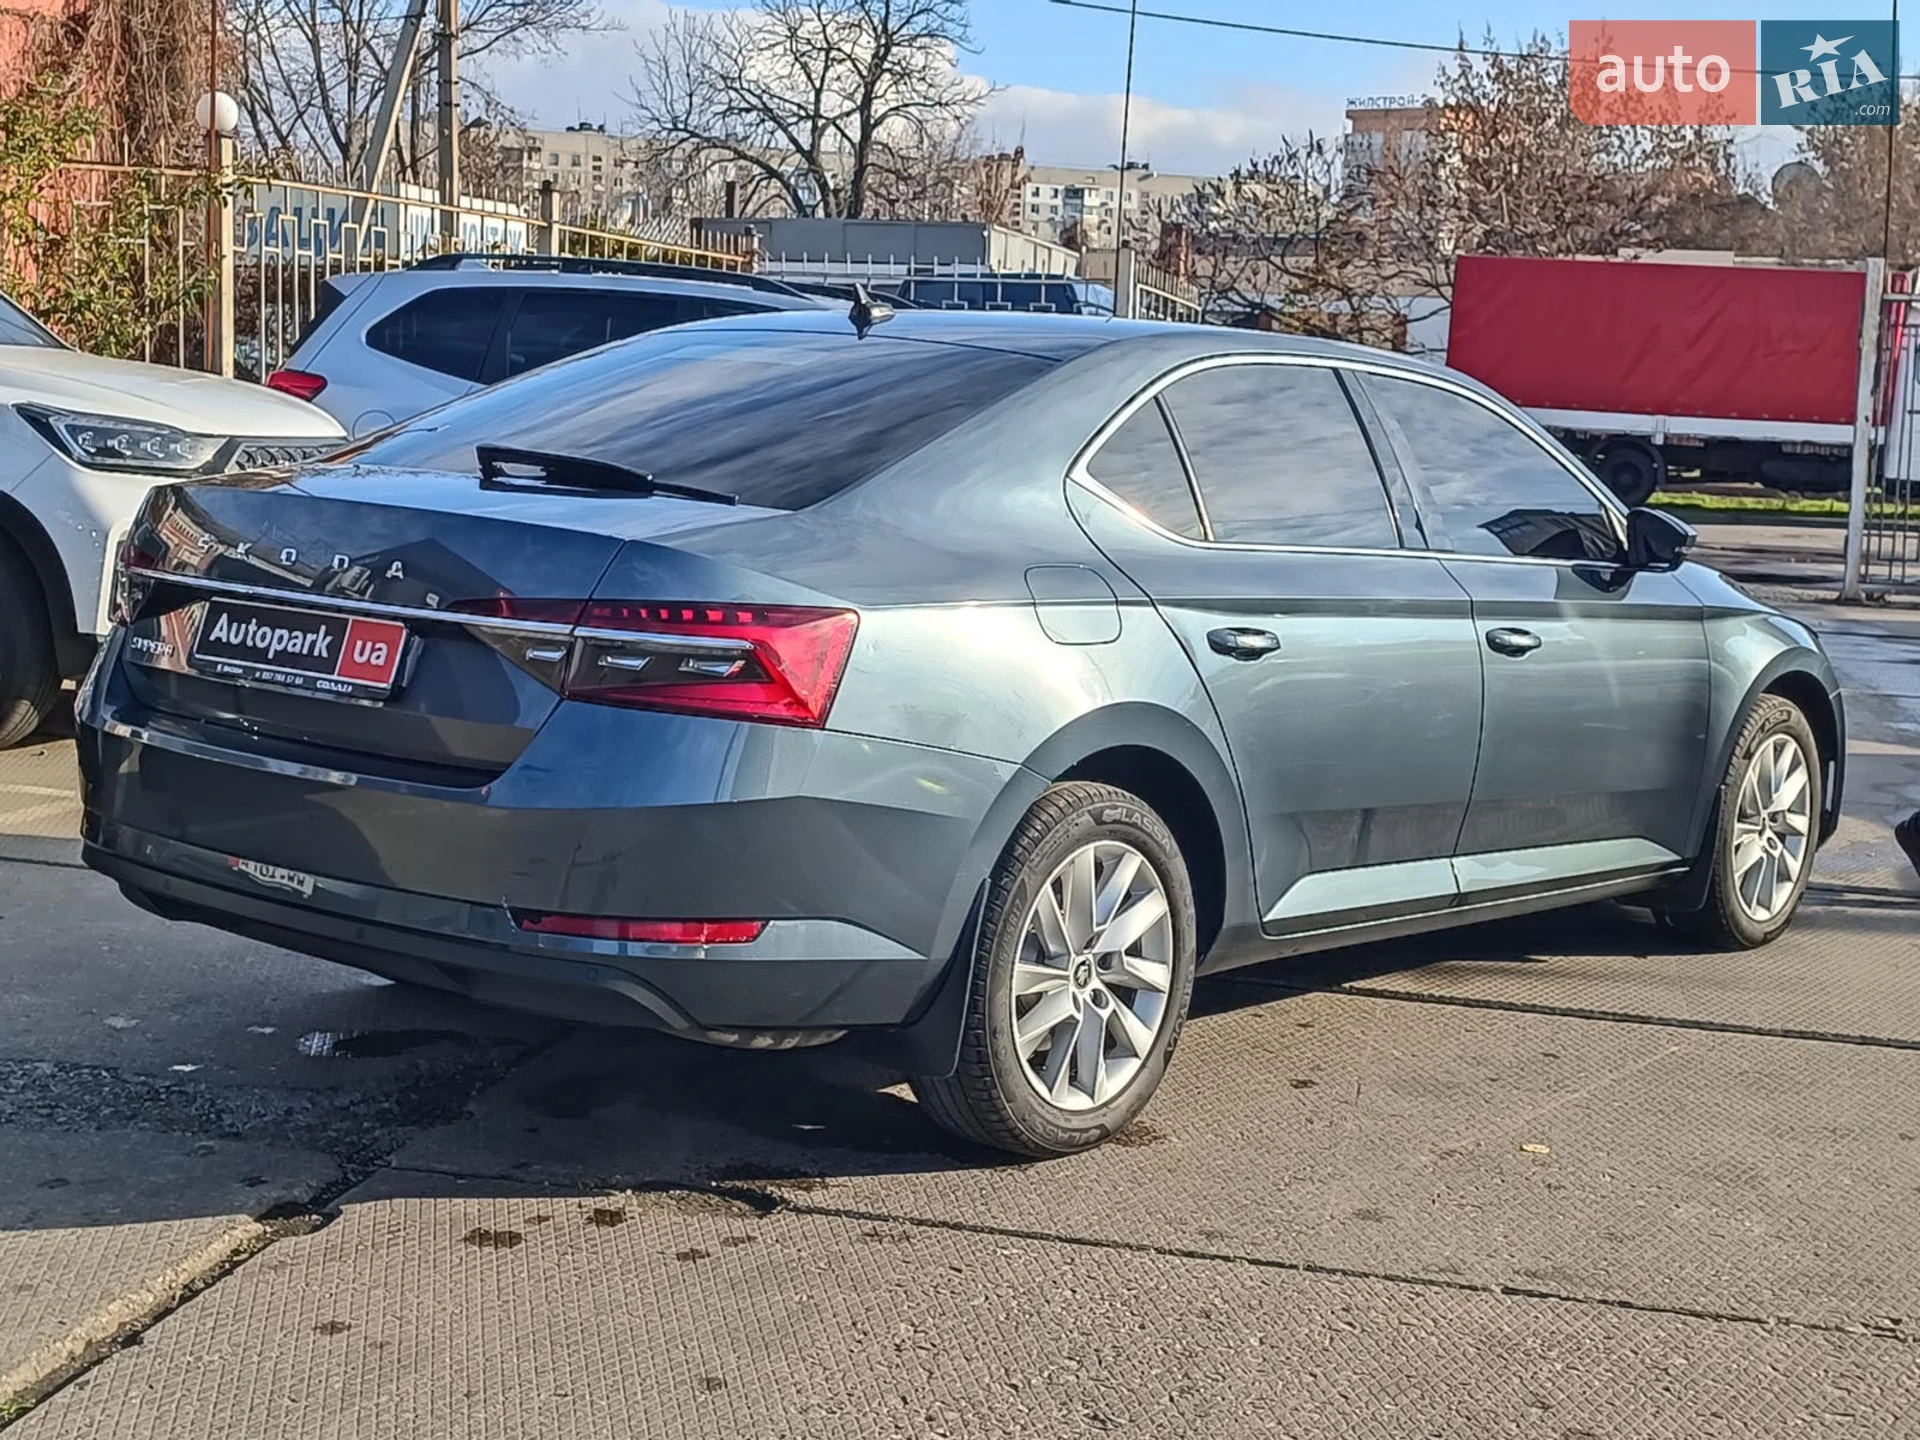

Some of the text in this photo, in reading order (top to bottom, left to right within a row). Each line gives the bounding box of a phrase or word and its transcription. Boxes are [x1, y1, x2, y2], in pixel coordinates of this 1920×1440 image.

[209, 613, 388, 666] Autopark ua
[1121, 807, 1172, 854] LASSA
